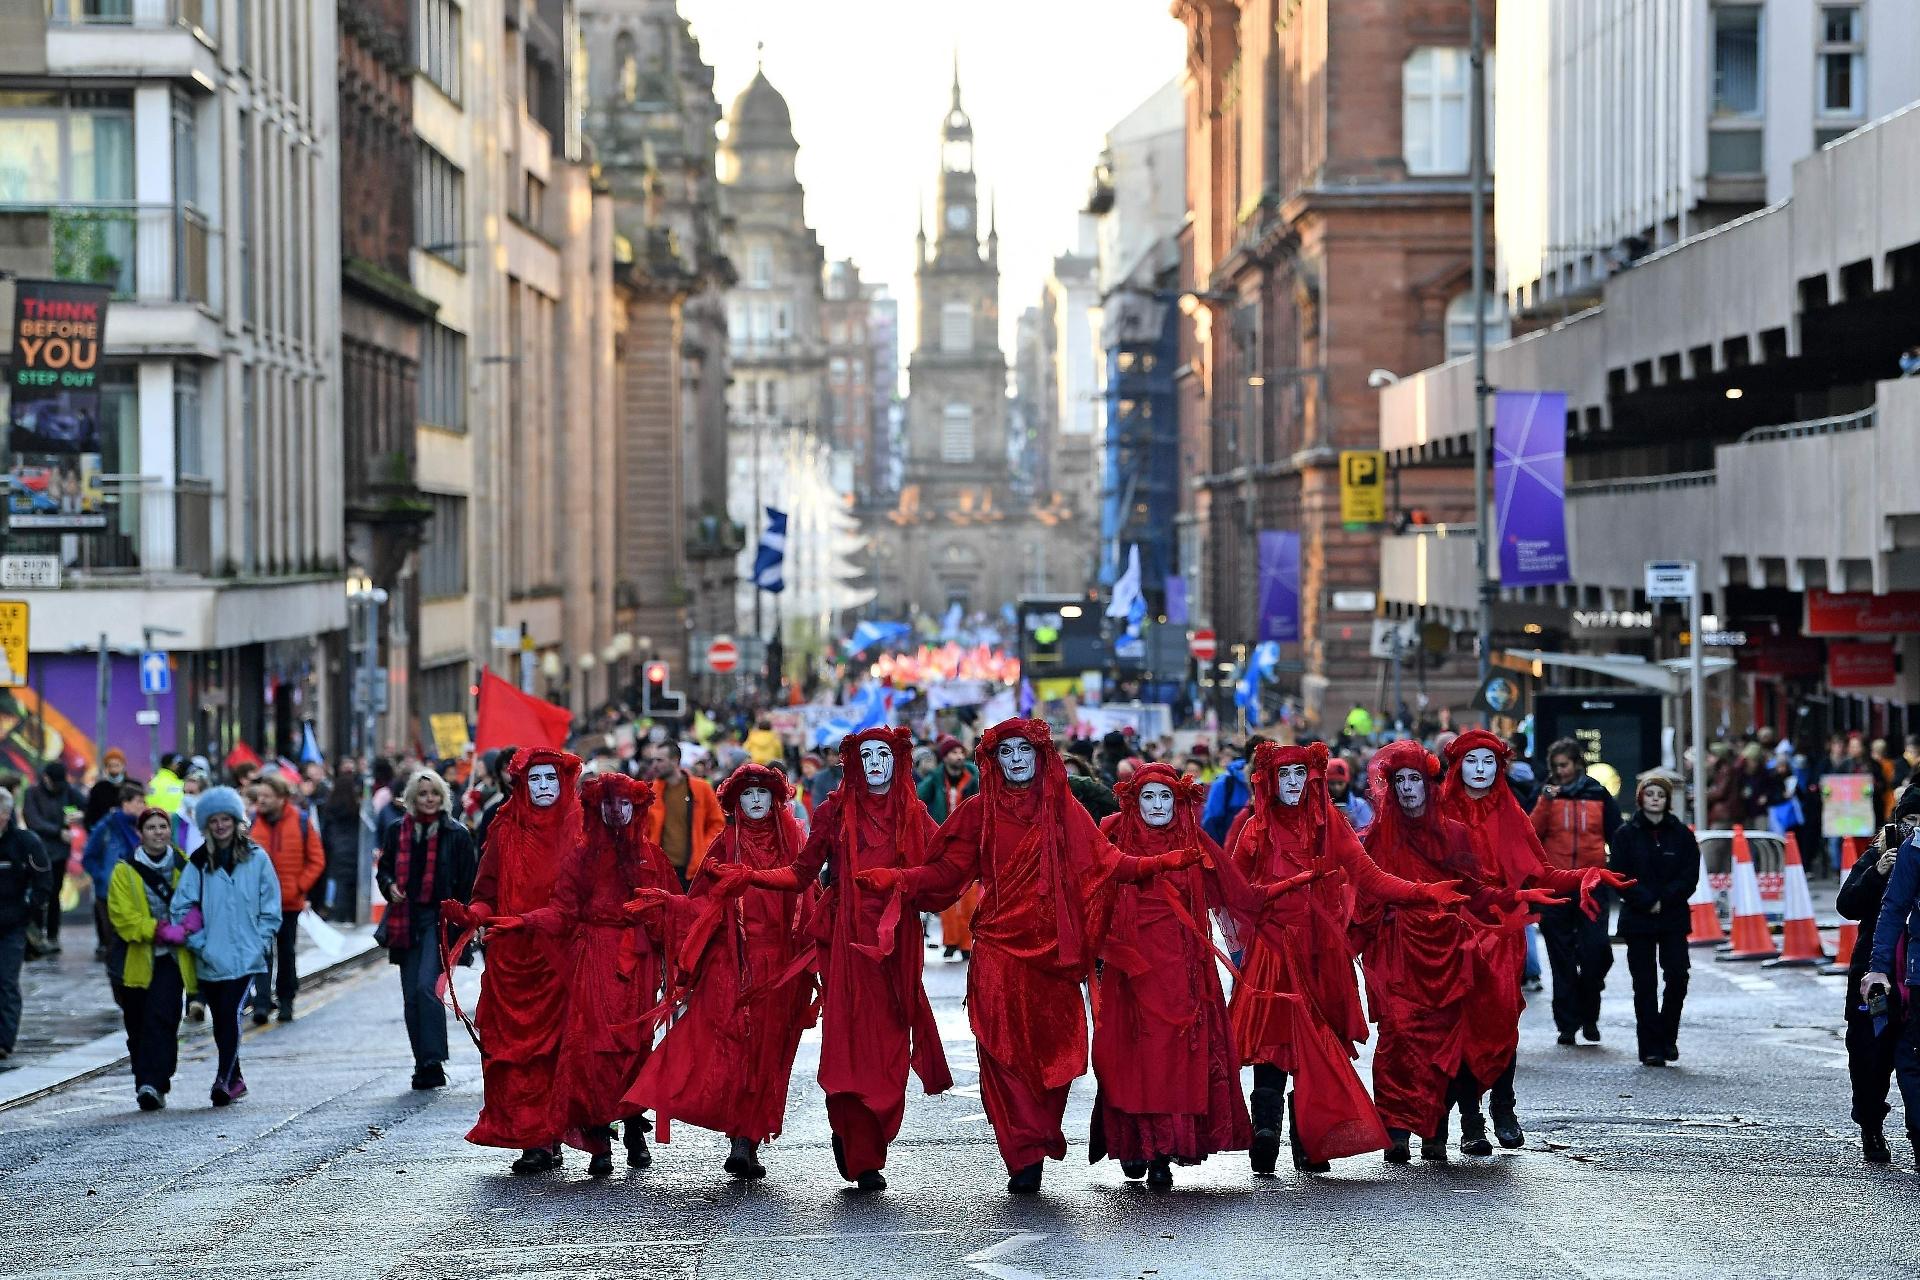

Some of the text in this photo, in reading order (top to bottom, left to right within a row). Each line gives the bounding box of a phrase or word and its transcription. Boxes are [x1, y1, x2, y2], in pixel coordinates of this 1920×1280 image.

[22, 298, 97, 320] THINK
[20, 319, 97, 339] BEFORE
[20, 337, 97, 369] YOU
[18, 370, 95, 387] STEP OUT
[1350, 459, 1374, 485] P
